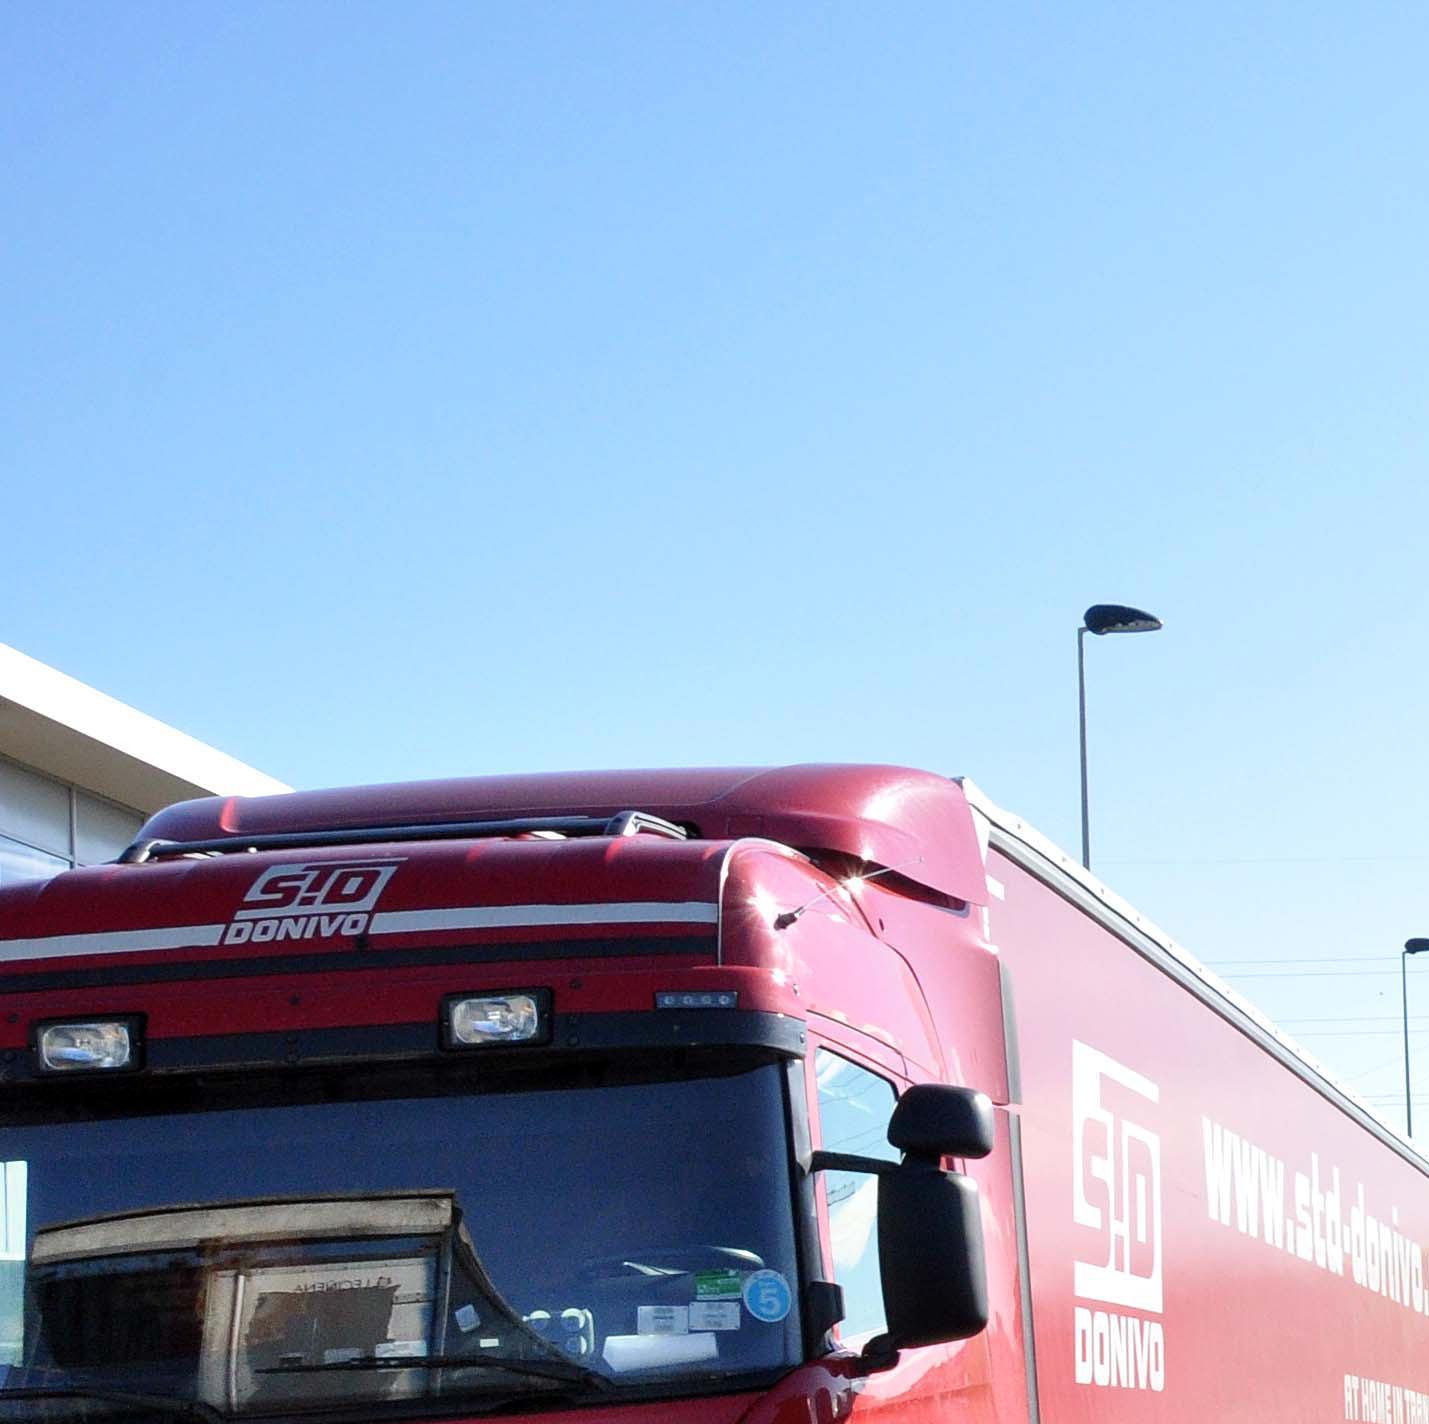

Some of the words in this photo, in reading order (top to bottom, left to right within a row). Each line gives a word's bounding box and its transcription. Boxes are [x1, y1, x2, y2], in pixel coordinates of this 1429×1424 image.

[223, 913, 369, 945] DONIVO
[1074, 1306, 1165, 1393] DONIVO
[1344, 1373, 1359, 1421] AT
